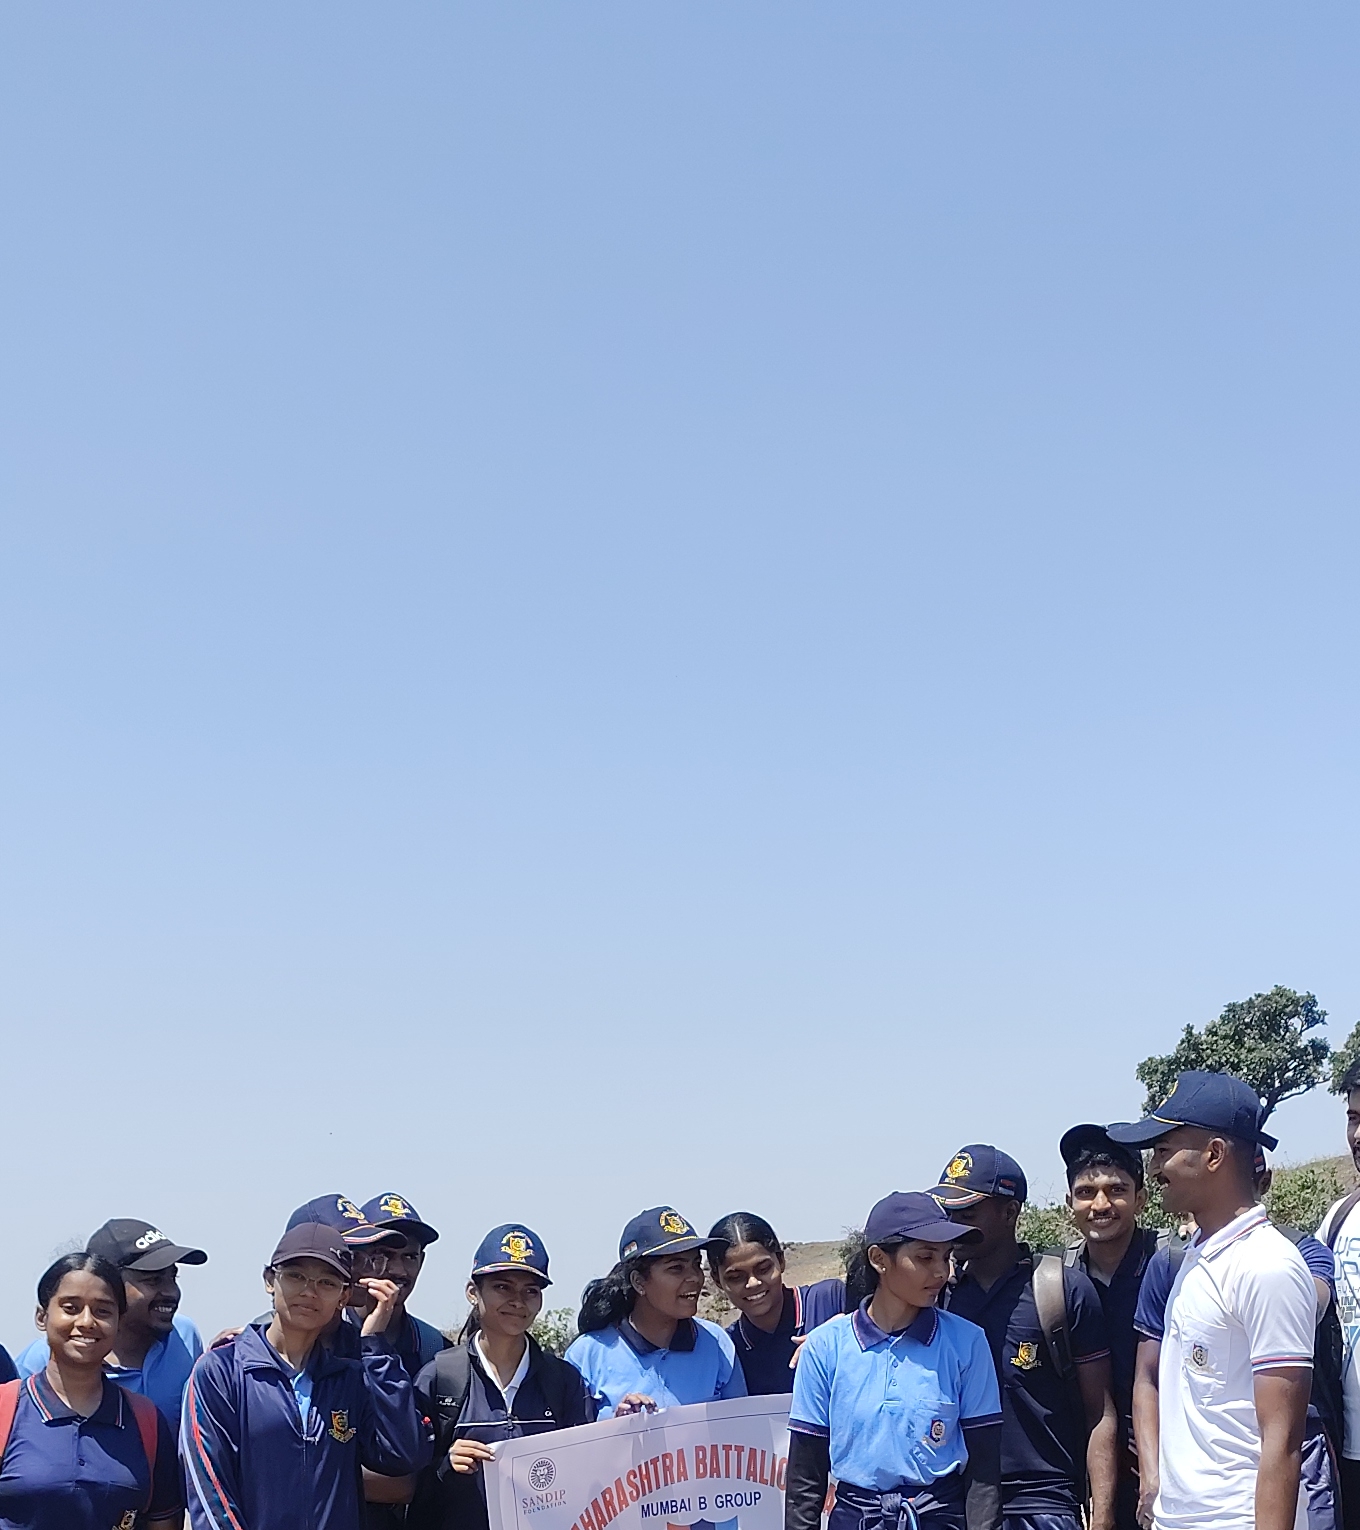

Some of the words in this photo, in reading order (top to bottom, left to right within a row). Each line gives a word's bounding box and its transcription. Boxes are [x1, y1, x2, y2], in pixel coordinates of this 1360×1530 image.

[522, 1489, 567, 1509] SANDIP
[523, 1500, 568, 1515] FOUNDATION
[641, 1497, 691, 1519] MUMBAI
[698, 1496, 708, 1511] B
[714, 1491, 762, 1509] GROUP
